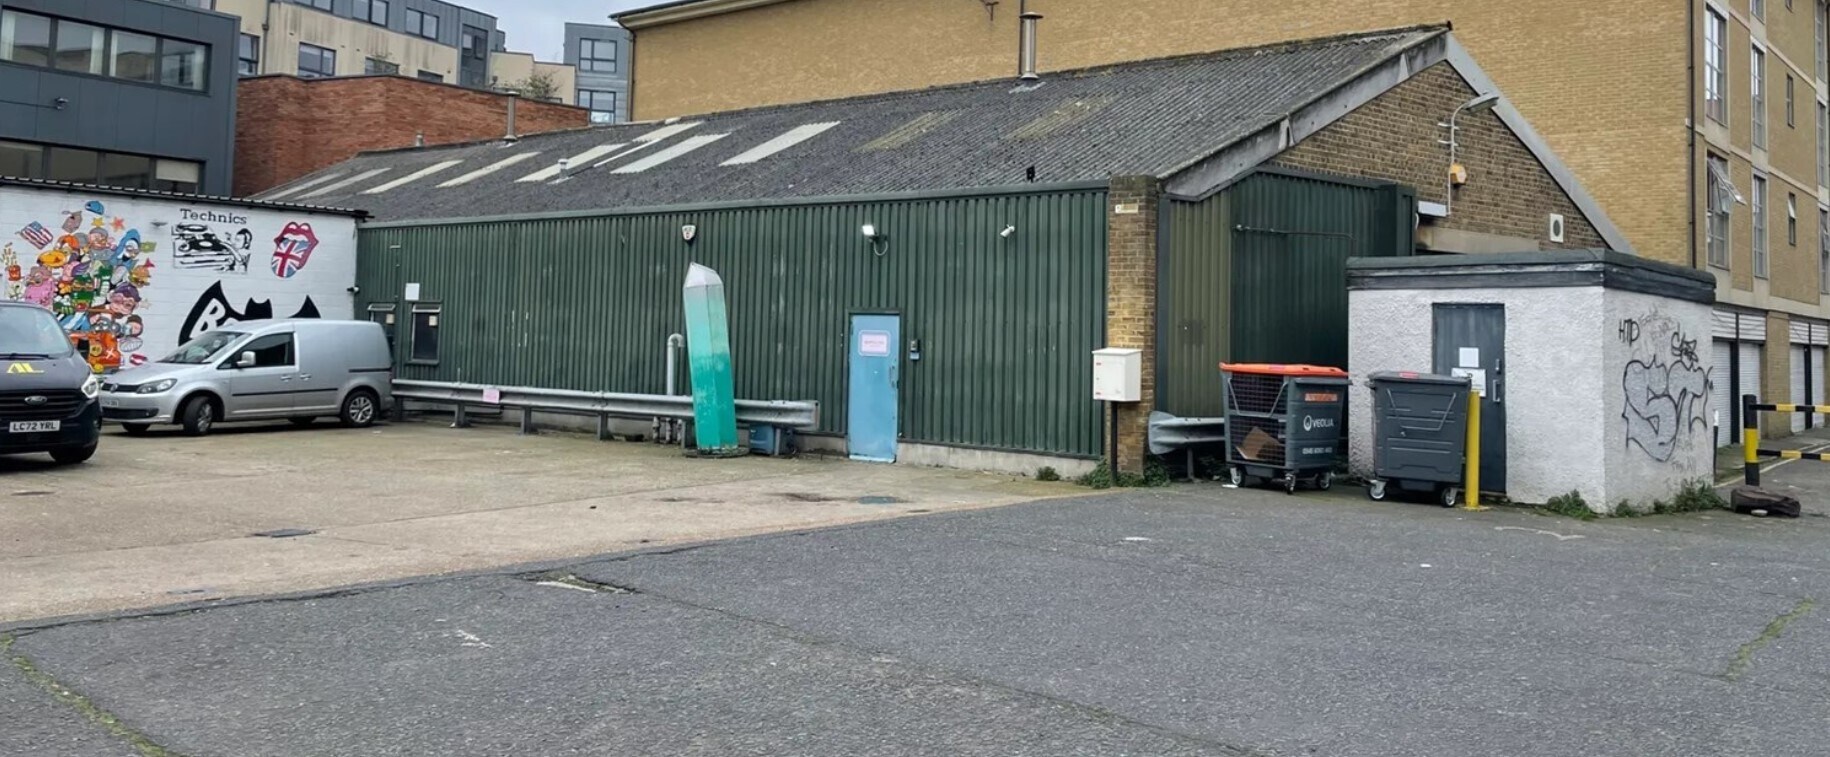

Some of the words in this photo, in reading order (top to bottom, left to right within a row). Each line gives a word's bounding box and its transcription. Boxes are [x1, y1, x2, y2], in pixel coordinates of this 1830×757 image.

[179, 208, 248, 224] Technics
[13, 422, 38, 431] LC72
[40, 421, 56, 430] YRL
[1312, 418, 1335, 428] VEOLIA
